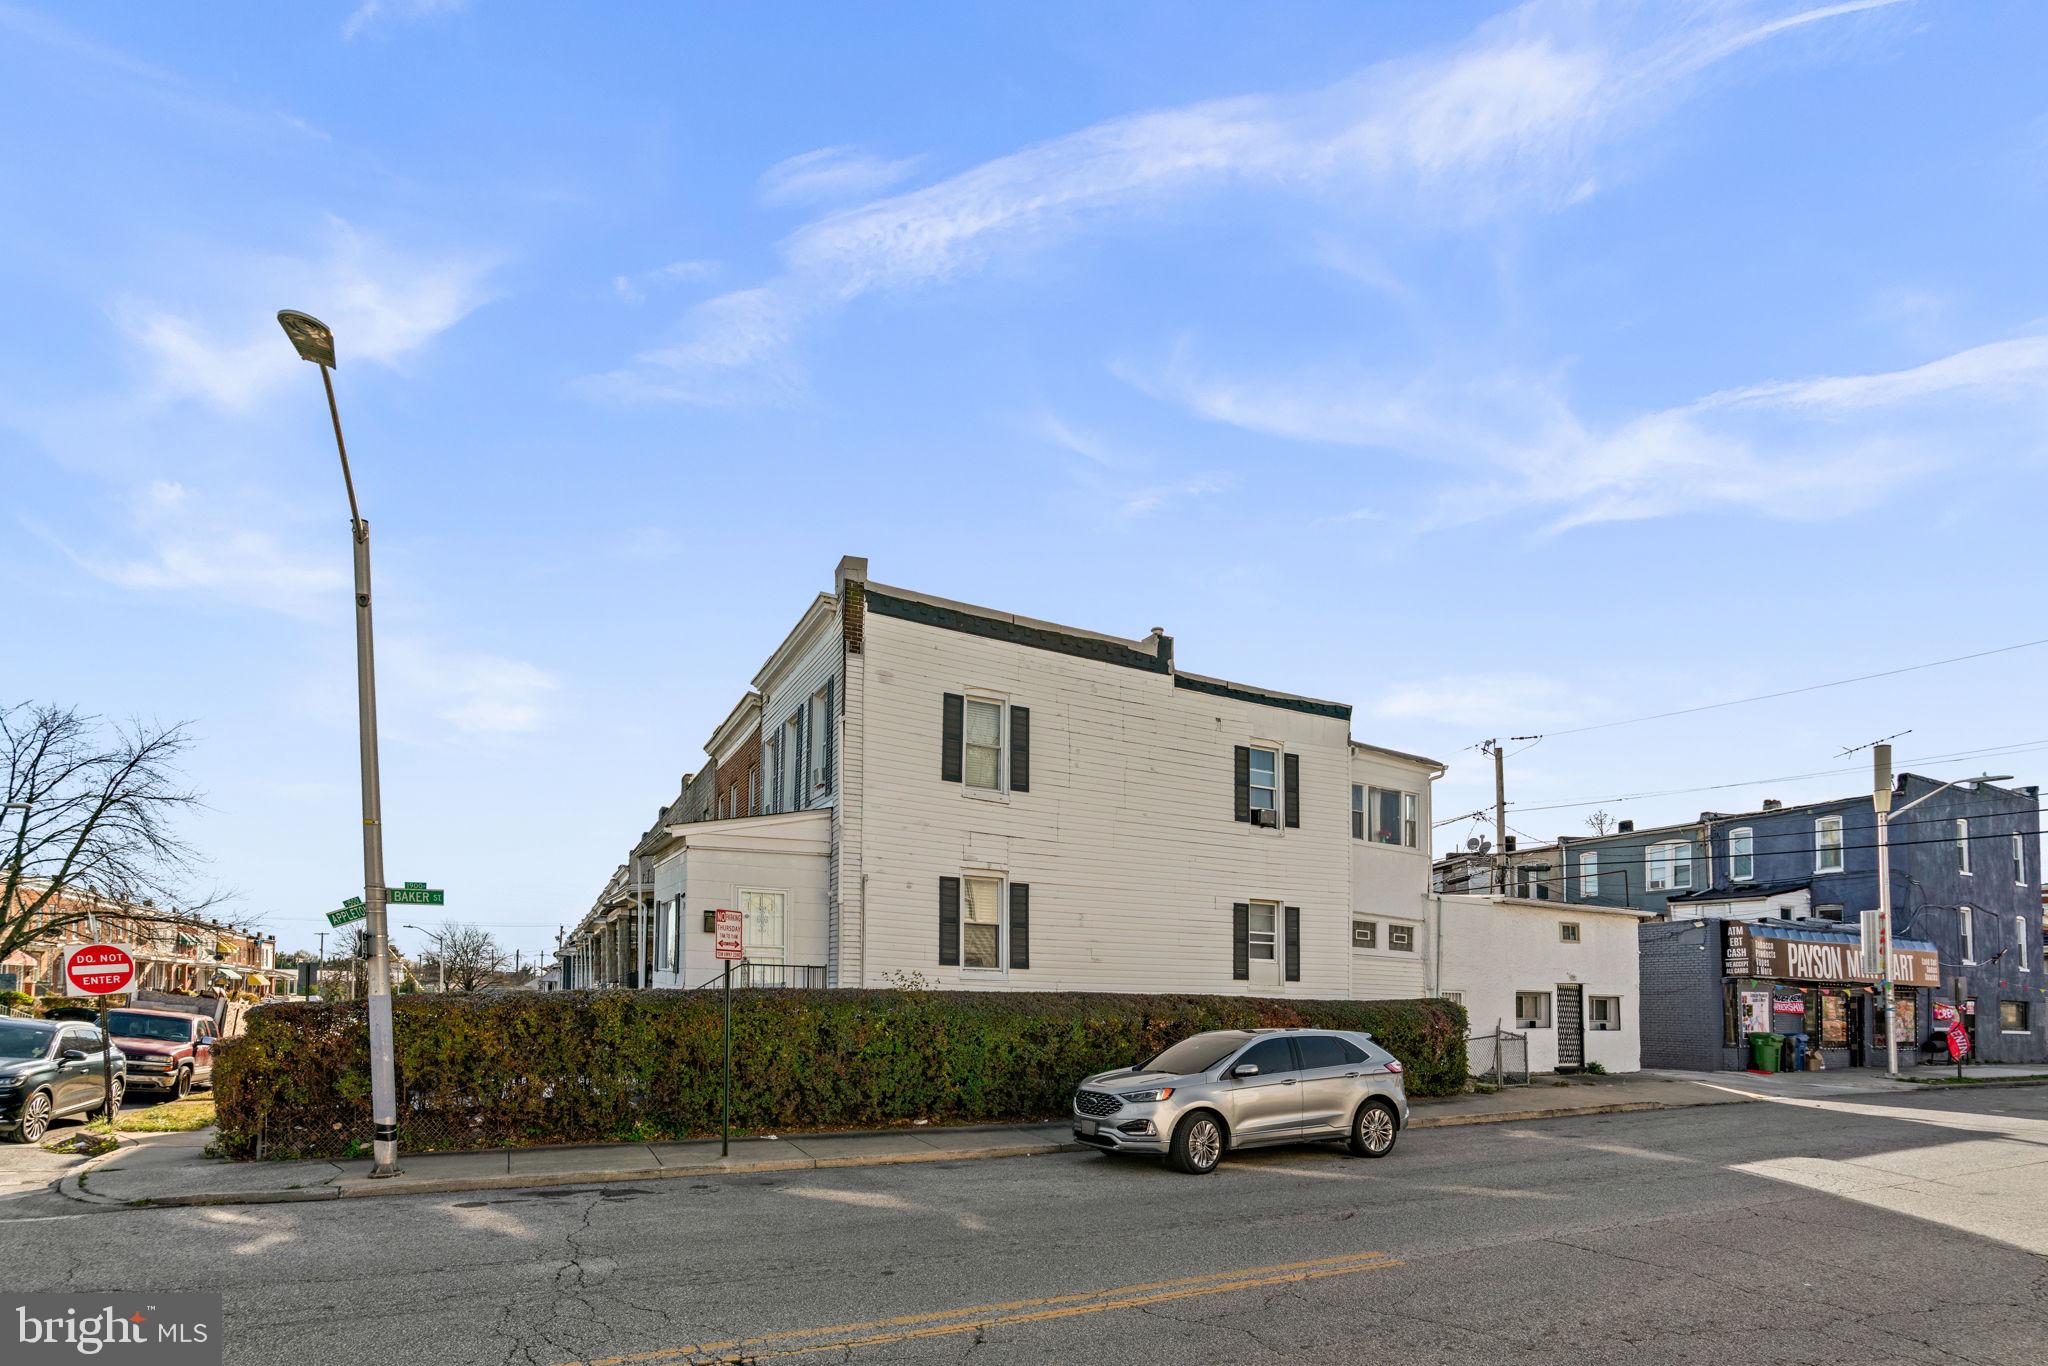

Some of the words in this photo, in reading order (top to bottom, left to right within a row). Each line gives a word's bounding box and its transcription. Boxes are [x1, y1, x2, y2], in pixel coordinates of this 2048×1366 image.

[394, 890, 430, 903] BAKER
[717, 911, 726, 922] NO
[726, 913, 741, 922] PARKING
[717, 924, 740, 932] THURSDAY
[1727, 926, 1744, 936] ATM
[1729, 937, 1743, 947] EBT
[76, 955, 94, 963] DO
[100, 953, 123, 962] NOT
[1726, 948, 1747, 958] CASH
[1787, 943, 1843, 980] PAYSON
[1890, 953, 1914, 981] ART
[83, 975, 121, 985] ENTER
